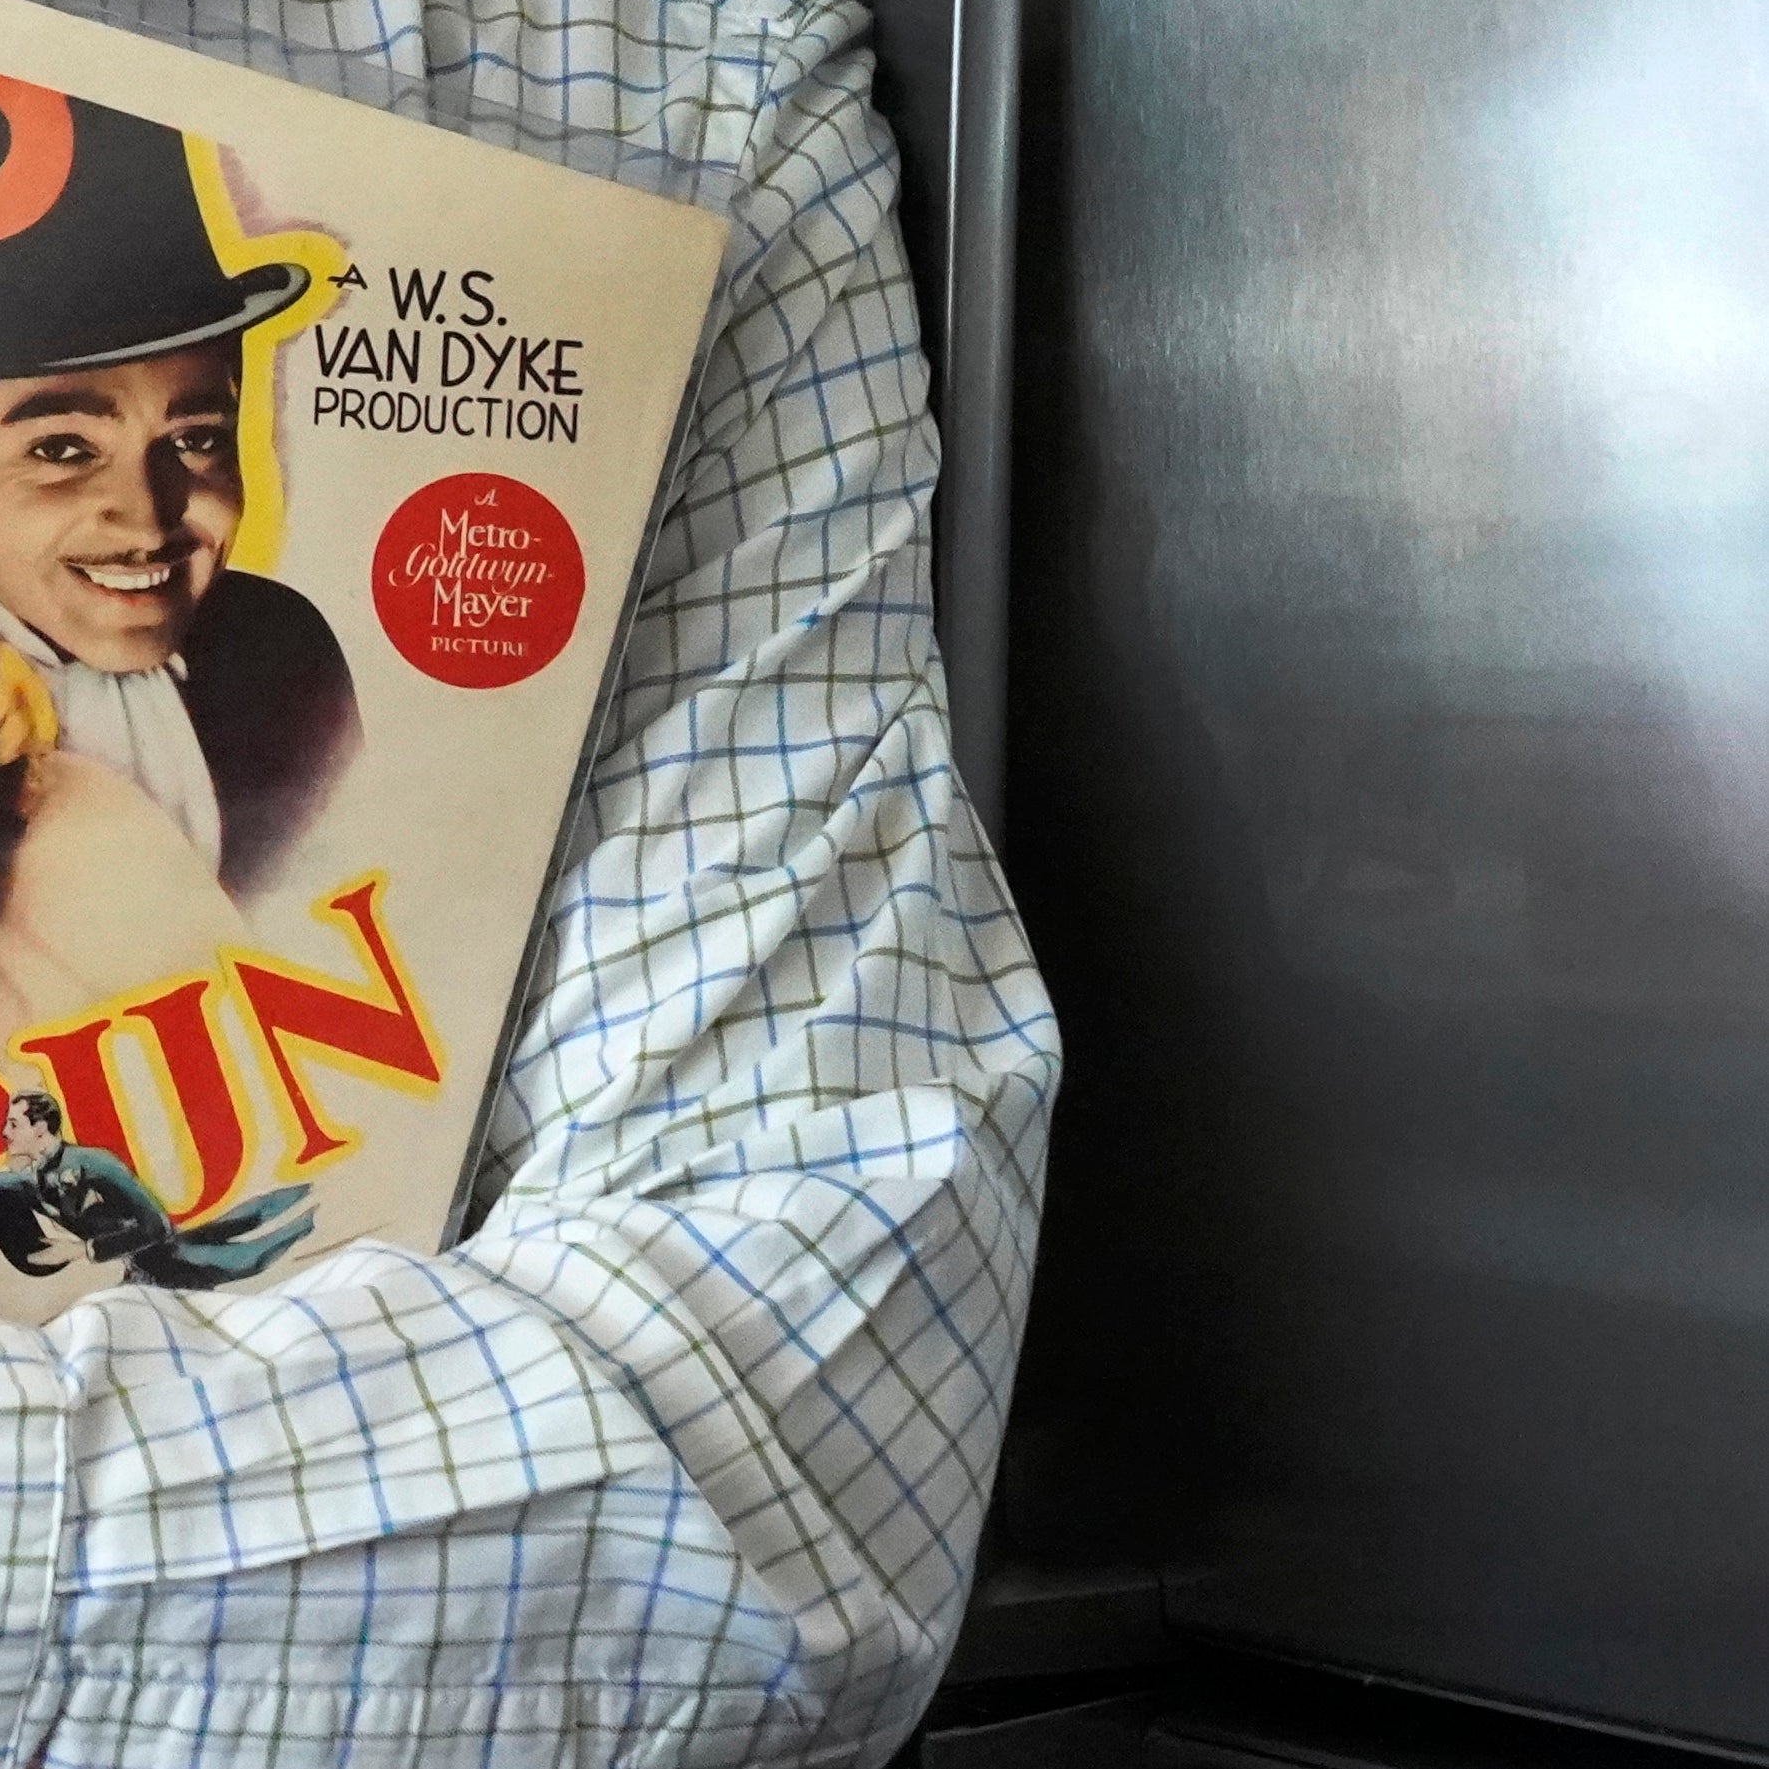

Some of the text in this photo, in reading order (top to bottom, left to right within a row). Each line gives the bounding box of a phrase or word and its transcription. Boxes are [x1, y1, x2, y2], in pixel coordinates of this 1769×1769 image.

[328, 263, 509, 328] A W. S.
[314, 323, 585, 397] VAN DYKE
[313, 386, 579, 445] PRODUCTION
[473, 488, 499, 508] A
[438, 507, 543, 559] Metro-
[388, 543, 556, 595] Goldwyn-
[430, 578, 534, 629] Mayer
[430, 635, 530, 659] PICTURE
